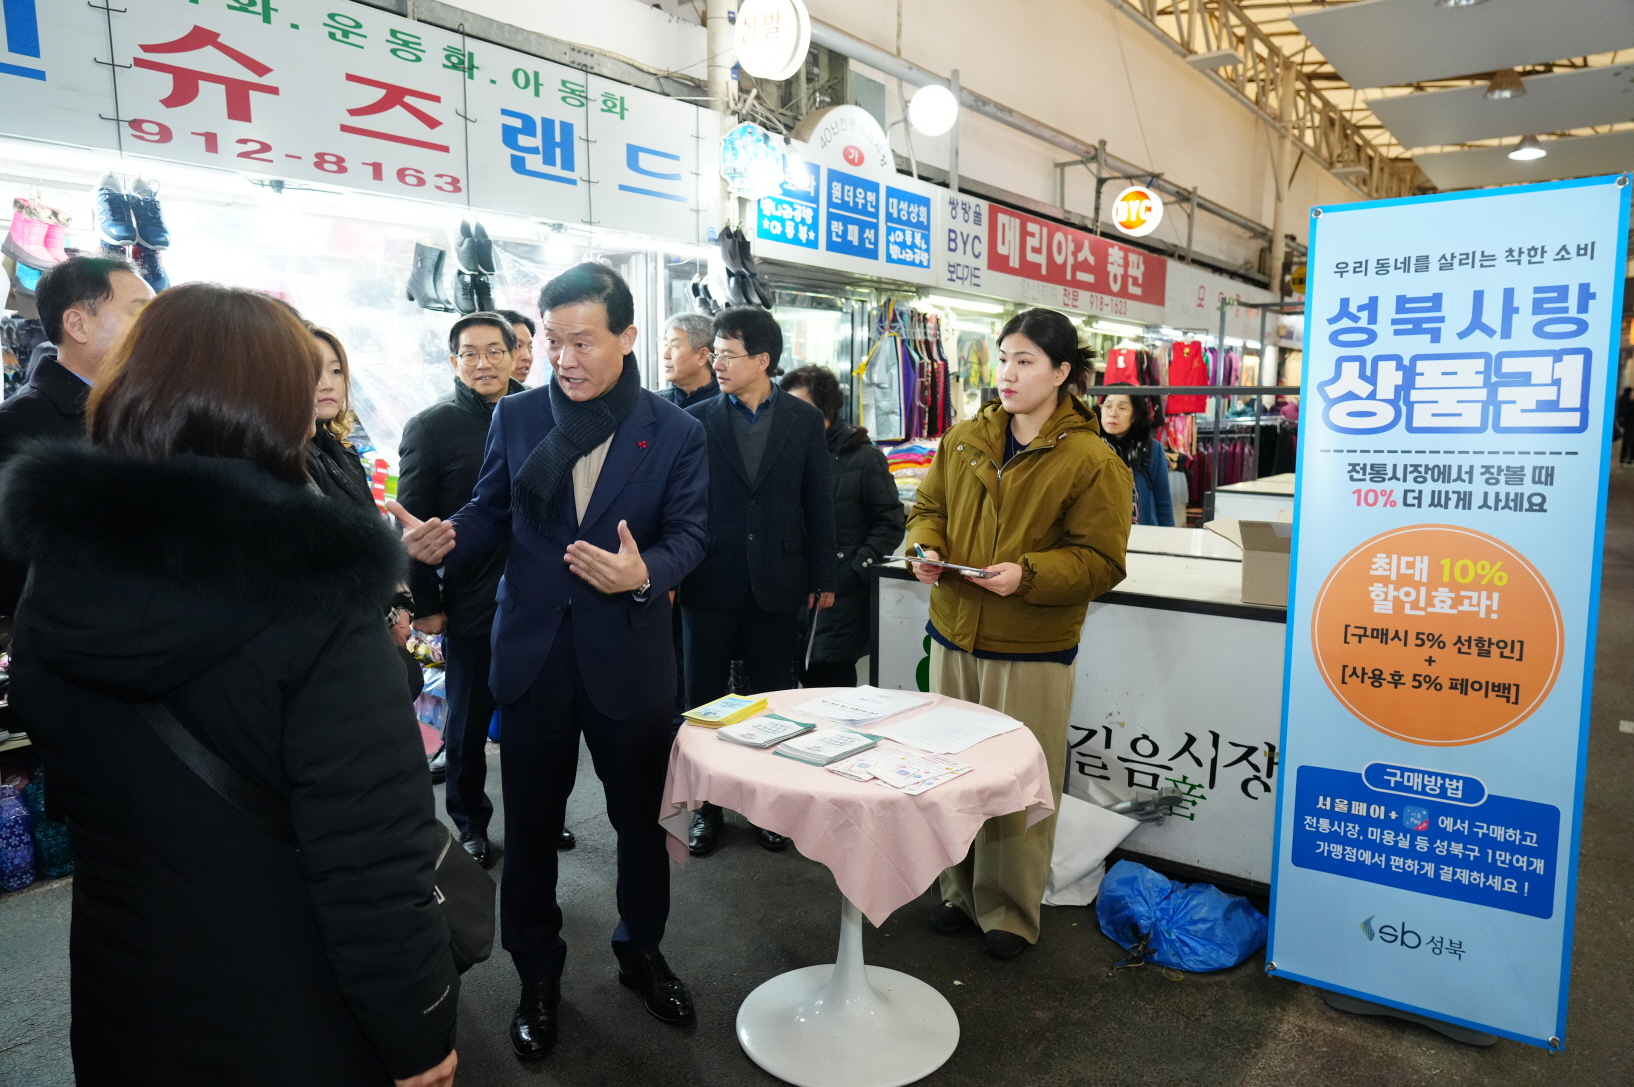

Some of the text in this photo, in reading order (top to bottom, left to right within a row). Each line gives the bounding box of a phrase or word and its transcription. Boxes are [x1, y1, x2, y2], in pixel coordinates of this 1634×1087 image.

[128, 119, 463, 194] 912-8163
[848, 148, 860, 164] 가
[831, 181, 876, 212] 원더우먼
[889, 197, 928, 226] 대성상회
[948, 195, 982, 226] 쌍방울
[1116, 199, 1152, 223] BYC
[948, 228, 982, 259] BYC
[997, 212, 1146, 296] 메리야스 총판
[1333, 241, 1597, 278] 우리 동네를 살리는 착한 소비
[947, 260, 981, 288] 보디가드
[1063, 287, 1080, 309] 전문
[1089, 293, 1128, 316] 918-1623
[1326, 282, 1597, 348] 성북사랑
[1317, 347, 1593, 435] 상품권
[1347, 462, 1555, 487] 전통시장에서 장볼 때
[1351, 488, 1548, 513] 10% 더 싸게 사세요
[1370, 553, 1508, 586] 최대 10%
[1368, 582, 1500, 619] 할인효과!
[1343, 624, 1525, 662] [구매시 5% 선할인]
[1341, 664, 1520, 705] [사용후 5% 페이백]
[1070, 724, 1279, 800] 길음시장
[1383, 768, 1464, 799] 구매방법
[1303, 815, 1546, 875] 전통시장, 미용실 등 성북구 1만여개
[1438, 815, 1469, 835] 에서
[1473, 822, 1538, 847] 구매하고
[1315, 841, 1386, 868] 가맹점에서
[1389, 855, 1435, 878] 편하게
[1438, 865, 1519, 894] 결제하세요
[1378, 922, 1467, 961] sb 성북
